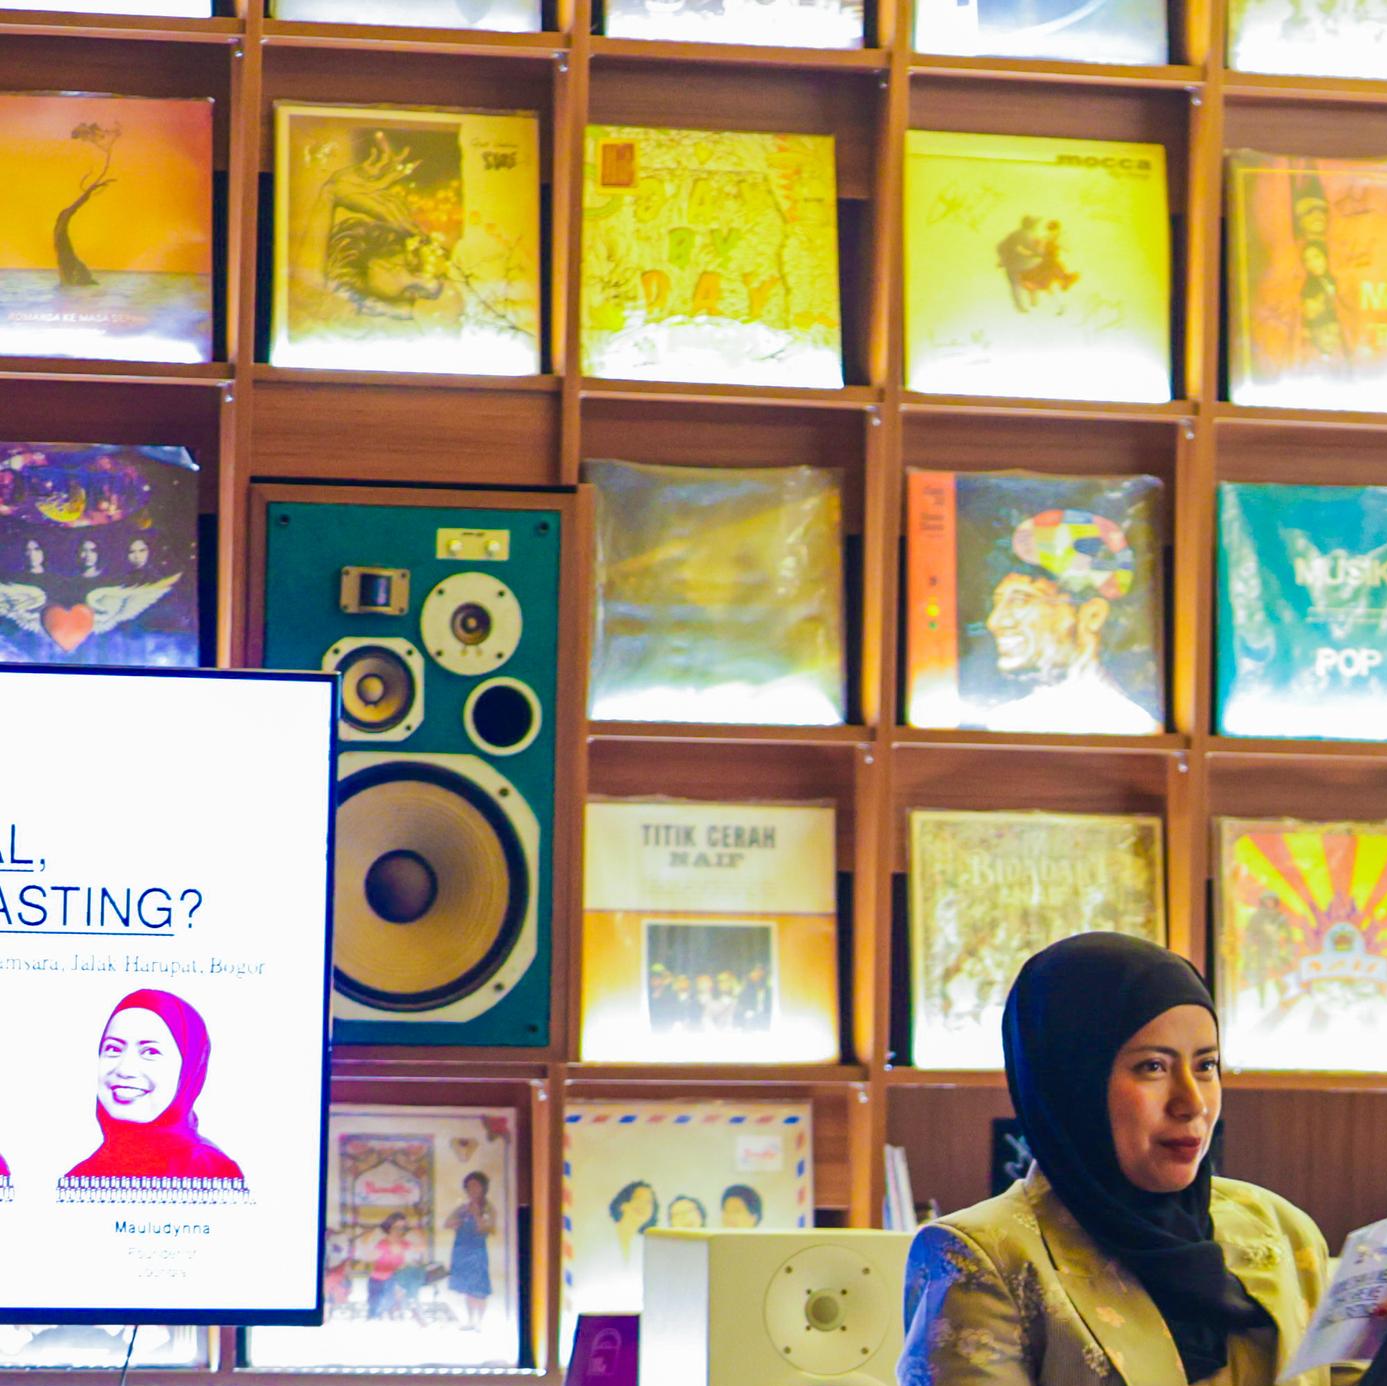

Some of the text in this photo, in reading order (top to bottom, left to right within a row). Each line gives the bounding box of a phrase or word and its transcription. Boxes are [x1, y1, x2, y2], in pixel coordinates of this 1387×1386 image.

[1056, 154, 1151, 170] mocca
[1315, 647, 1383, 677] POP
[0, 823, 46, 872] L,
[641, 824, 697, 848] TITIK
[669, 852, 745, 869] NAIF
[70, 954, 117, 973] Jalak
[210, 957, 266, 979] Bogor
[115, 1221, 211, 1237] Mauludynna
